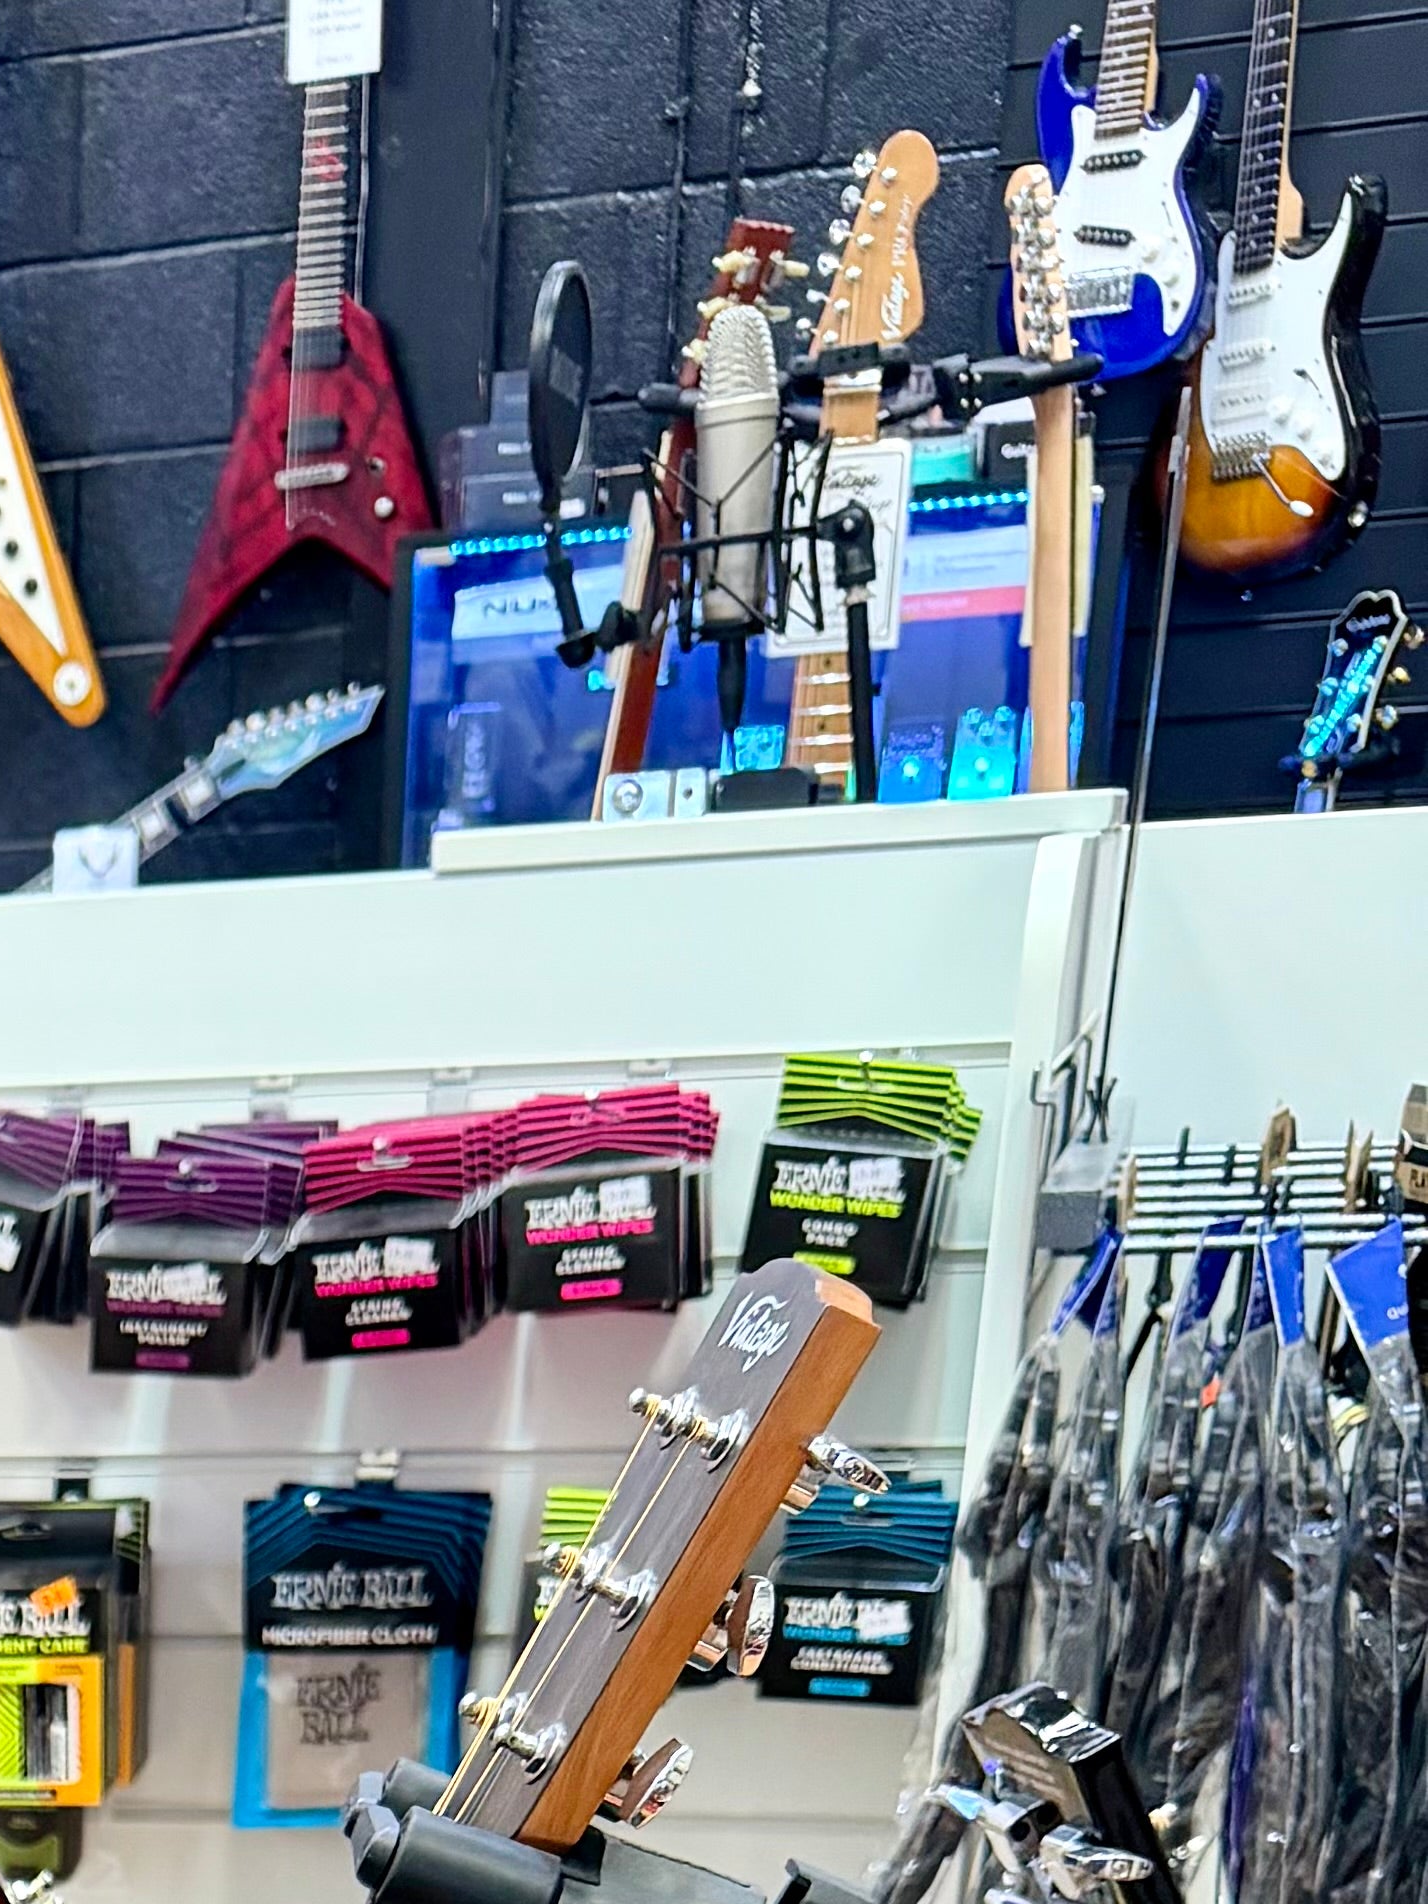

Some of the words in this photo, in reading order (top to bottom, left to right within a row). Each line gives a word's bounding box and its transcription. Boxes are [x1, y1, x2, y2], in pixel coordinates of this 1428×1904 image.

[717, 1290, 792, 1373] Vintage
[269, 1561, 360, 1610] ERNIE
[360, 1567, 436, 1610] BALL
[39, 1636, 90, 1654] CARE
[296, 1661, 382, 1708] ERNIE
[299, 1707, 370, 1746] BALL
